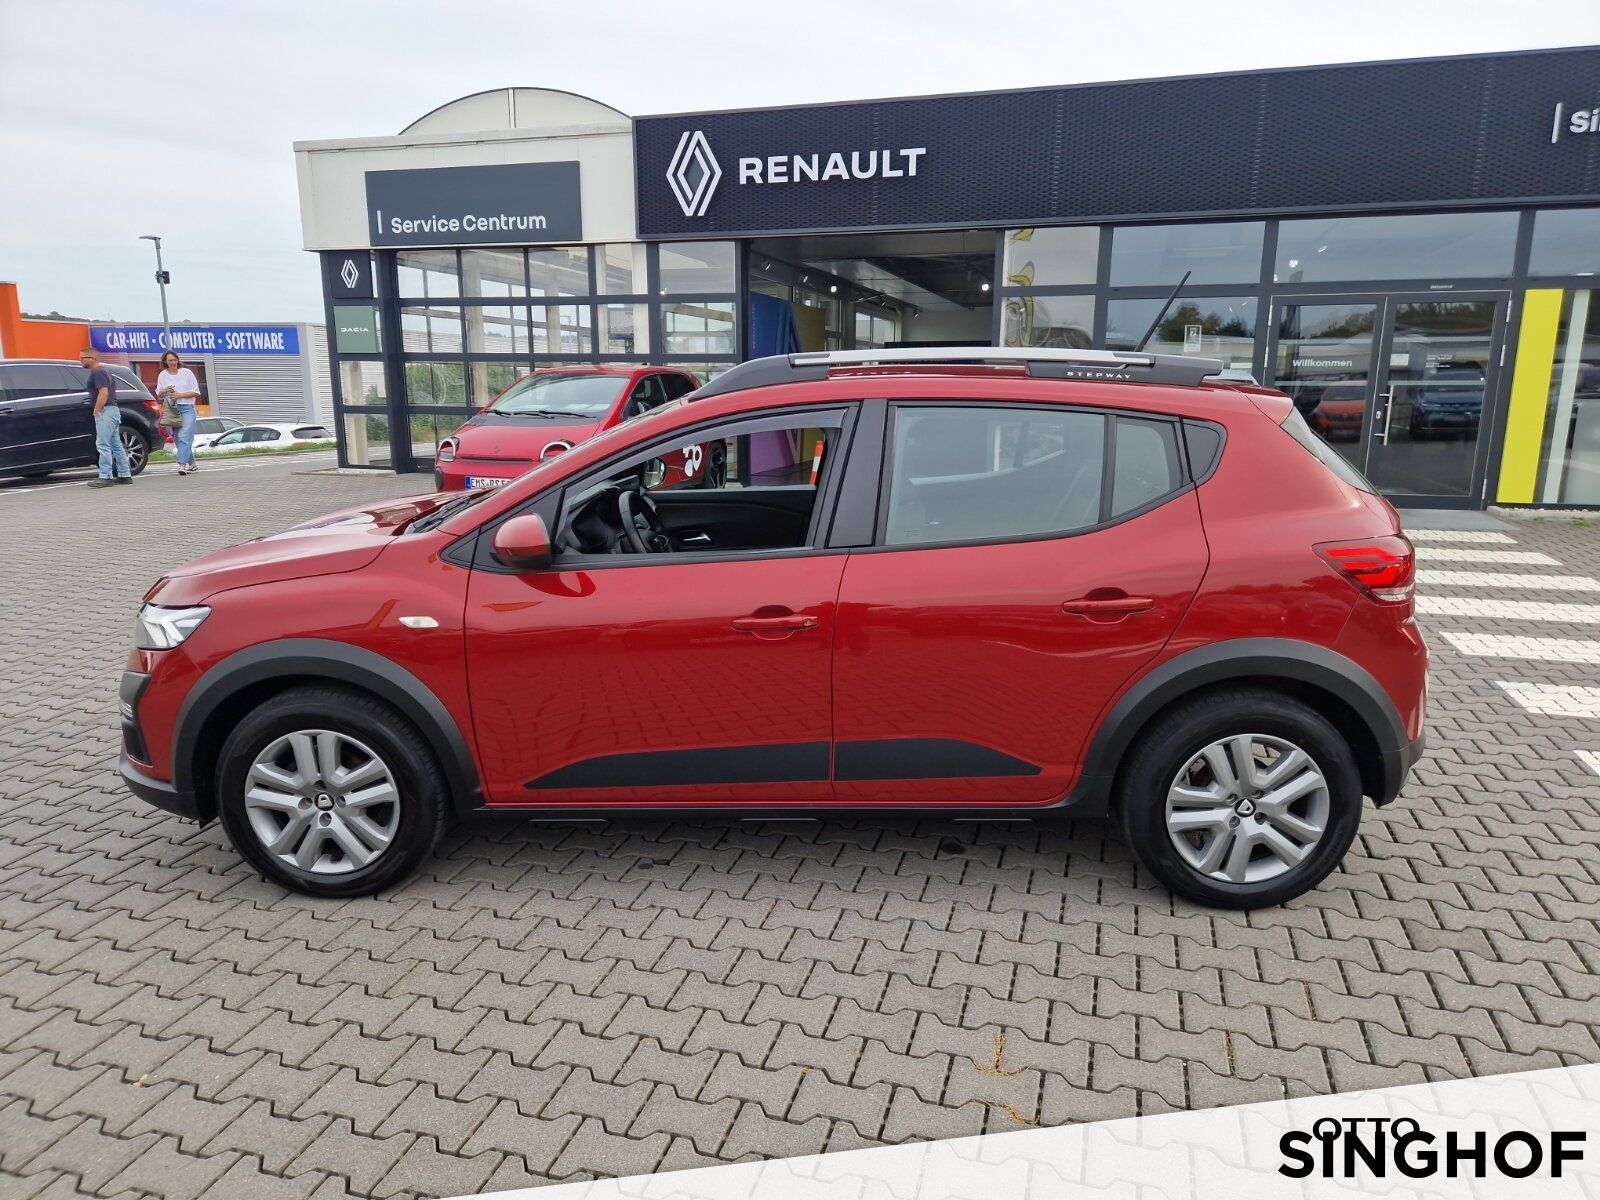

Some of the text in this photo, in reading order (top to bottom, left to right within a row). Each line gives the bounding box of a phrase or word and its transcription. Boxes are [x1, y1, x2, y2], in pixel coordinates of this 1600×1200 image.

[1569, 107, 1600, 133] Si
[738, 147, 927, 185] RENAULT
[391, 214, 547, 233] Service Centrum
[106, 332, 150, 349] CAR-HIFI
[225, 332, 285, 350] SOFTWARE
[1292, 358, 1353, 367] Willkommen
[1066, 371, 1131, 379] STEPWAY
[470, 478, 485, 488] EMS
